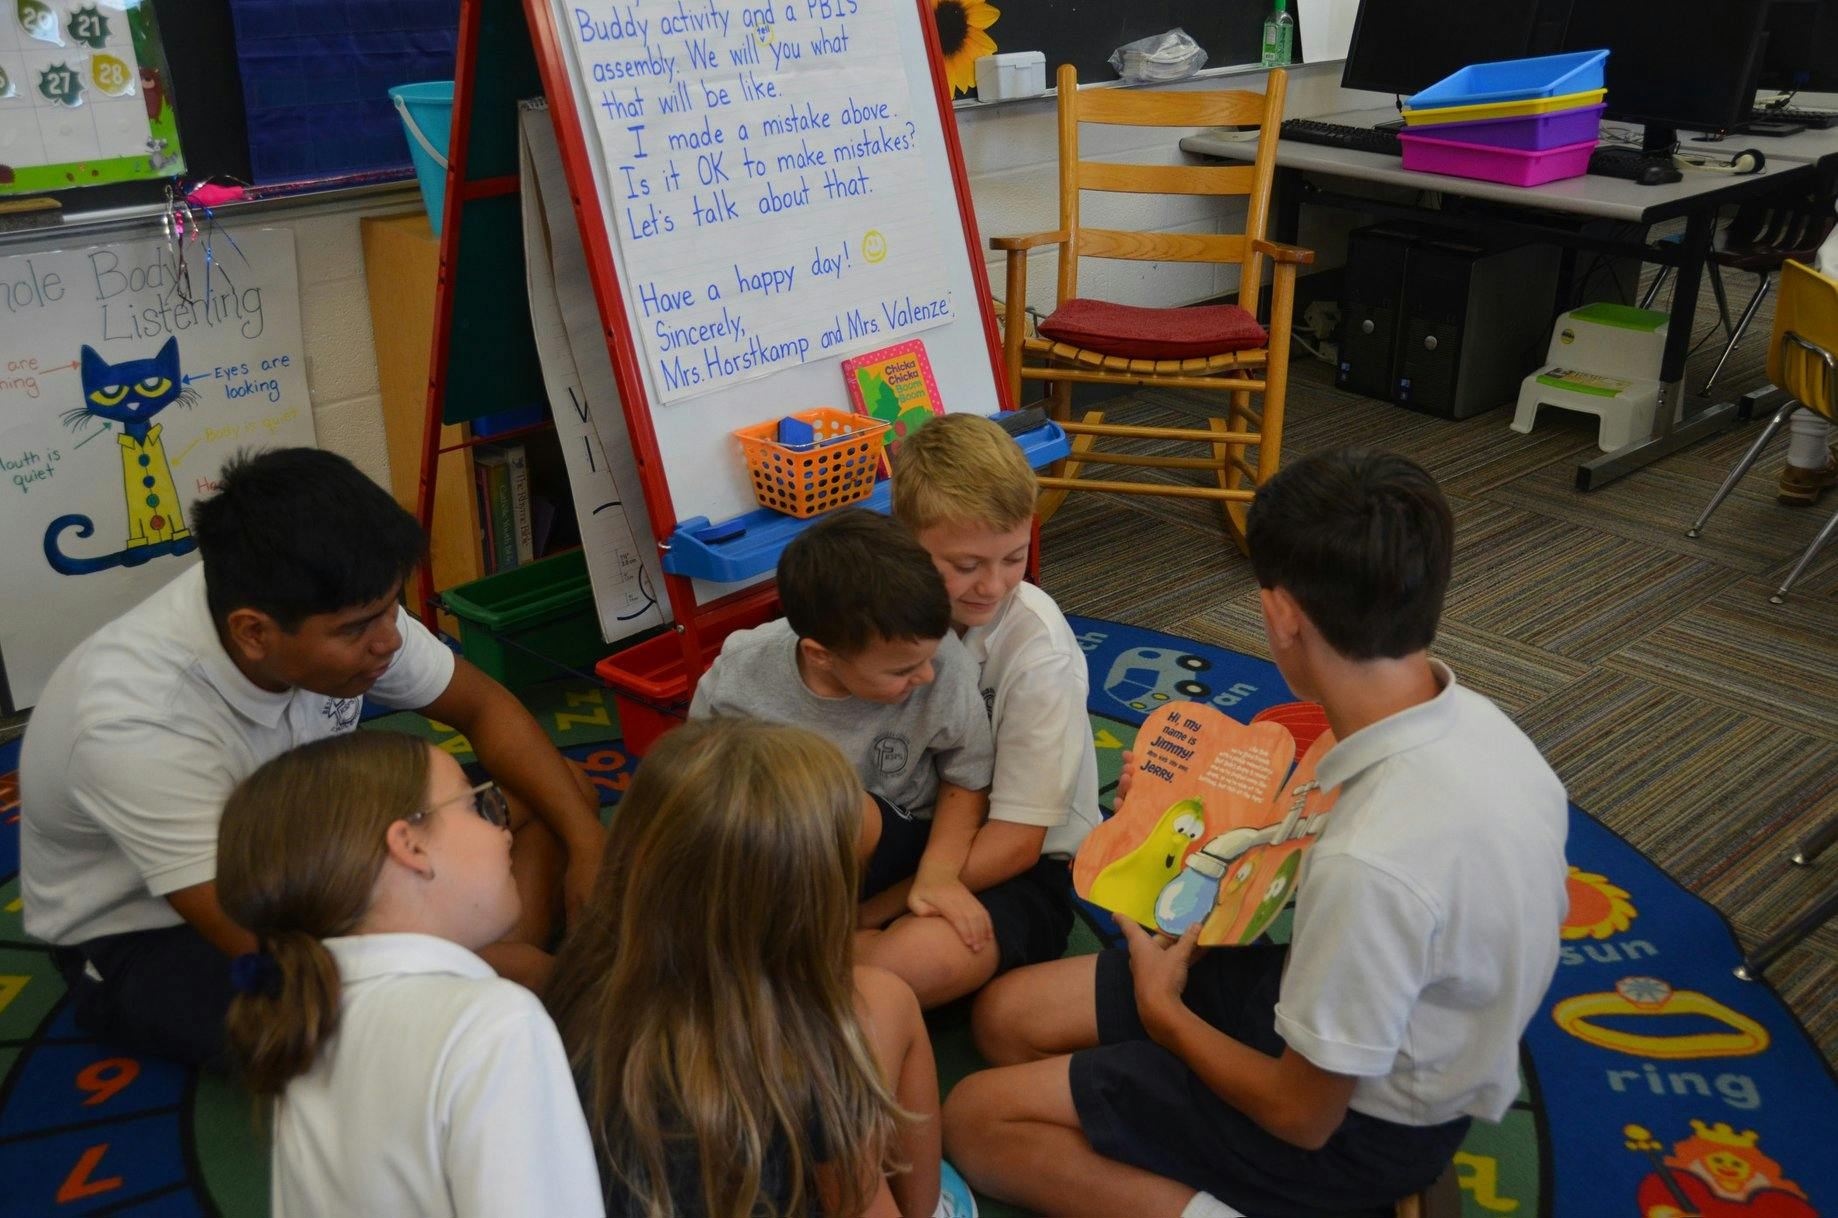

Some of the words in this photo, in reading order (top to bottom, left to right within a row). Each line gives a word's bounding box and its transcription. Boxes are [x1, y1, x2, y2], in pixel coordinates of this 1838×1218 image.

[79, 15, 101, 37] 21
[575, 8, 649, 46] Buddy
[661, 2, 730, 38] activity
[743, 3, 775, 28] and
[786, 5, 797, 21] a
[592, 46, 680, 84] assembly.
[685, 39, 719, 71] We
[730, 33, 760, 67] will
[769, 39, 801, 71] you
[811, 27, 850, 56] what
[48, 72, 71, 95] 27
[100, 63, 123, 84] 28
[601, 87, 645, 120] that
[658, 82, 692, 115] will
[701, 78, 732, 109] be
[739, 70, 783, 102] like.
[627, 124, 648, 158] I
[668, 116, 725, 151] made
[738, 123, 750, 141] a
[763, 102, 831, 138] mistake
[841, 96, 899, 125] above.
[619, 166, 650, 200] Is
[663, 160, 680, 192] it
[698, 150, 730, 186] OK
[743, 147, 766, 179] to
[777, 138, 827, 173] make
[834, 121, 916, 163] mistakes?
[627, 204, 675, 240] Let's
[693, 189, 740, 227] talk
[759, 175, 810, 214] about
[824, 166, 874, 200] that.
[88, 246, 181, 306] Body
[639, 283, 695, 318] Have
[707, 283, 721, 301] a
[735, 264, 796, 297] happy
[811, 241, 852, 279] day!
[103, 287, 264, 340] Listening
[655, 307, 746, 352] Sincerely,
[660, 357, 706, 392] Mrs.
[704, 335, 810, 381] Horstkamp
[821, 316, 844, 350] and
[847, 309, 880, 340] Mrs.
[8, 359, 38, 372] are
[215, 366, 249, 379] Eyes
[261, 354, 291, 371] are
[885, 360, 916, 375] Chicka
[888, 370, 919, 385] Chicka
[225, 377, 280, 402] looking
[48, 448, 61, 462] is
[13, 463, 55, 494] quiet
[1163, 726, 1187, 741] name
[1188, 736, 1198, 746] is
[1168, 712, 1181, 726] Hi,
[1184, 719, 1202, 732] my
[1151, 736, 1195, 760] Jimmy!
[1559, 940, 1659, 965] sun
[1606, 1064, 1761, 1109] ring
